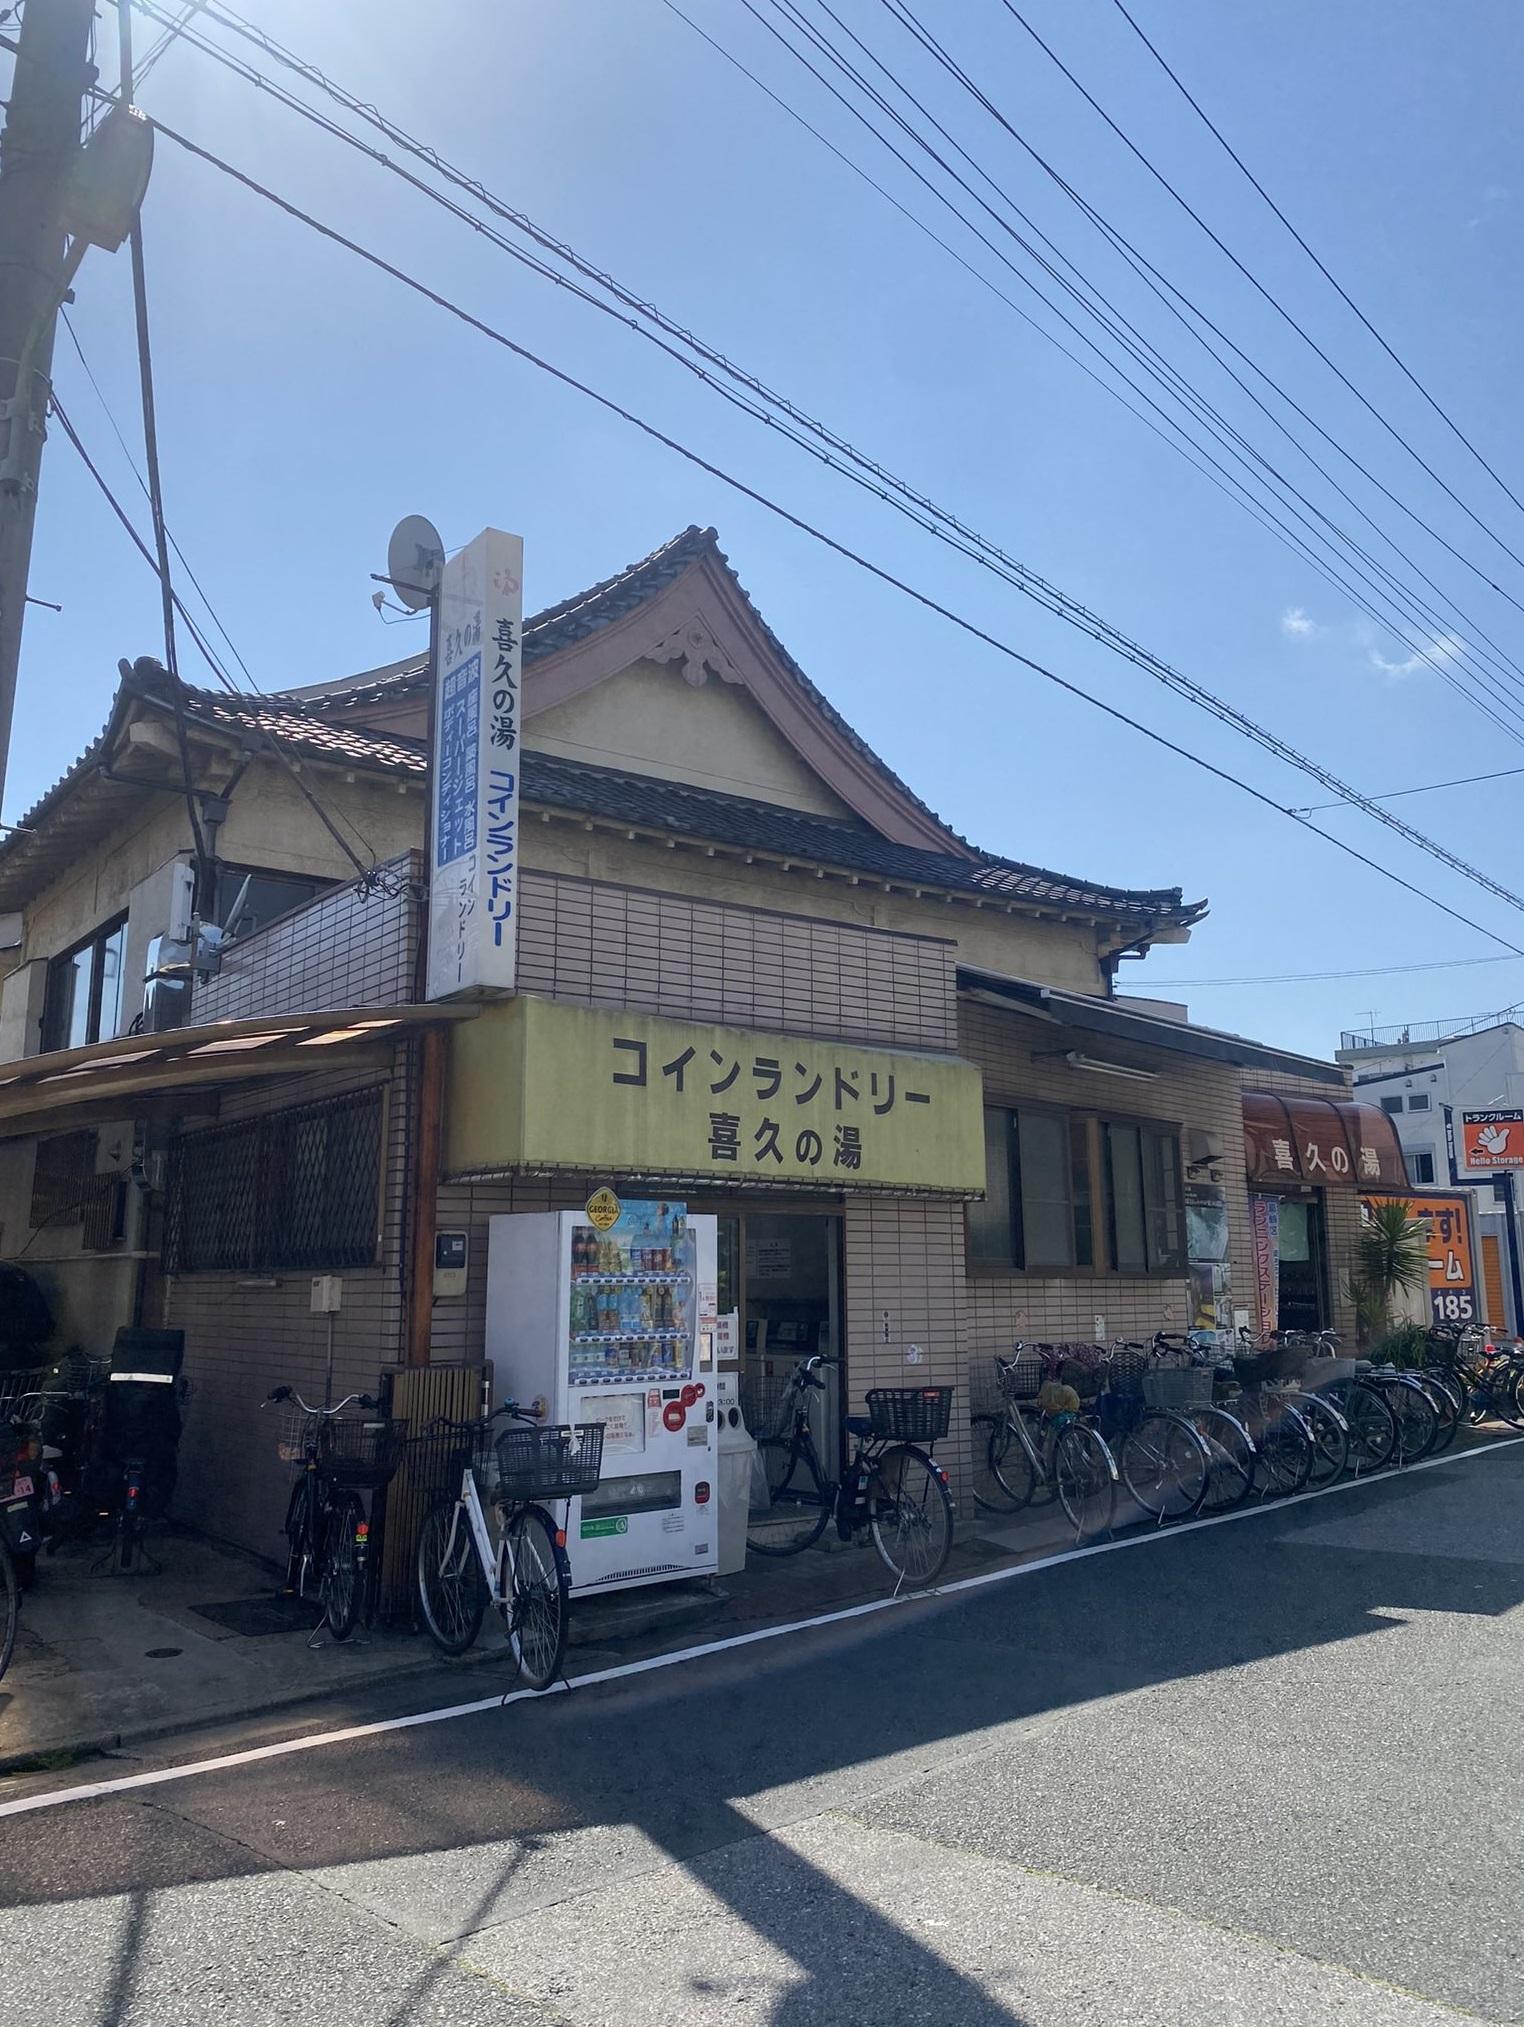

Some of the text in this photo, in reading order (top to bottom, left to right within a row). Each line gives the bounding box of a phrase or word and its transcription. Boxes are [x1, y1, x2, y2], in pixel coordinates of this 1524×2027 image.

[487, 618, 519, 947] 喜久の湯 コインランドリー
[467, 853, 476, 916] コイン
[458, 878, 467, 983] ランドリー
[612, 1037, 931, 1115] コインランドリー
[707, 1112, 863, 1171] 喜久の湯
[1465, 1112, 1522, 1122] トランクルーム
[1272, 1139, 1381, 1176] 喜久の湯
[1470, 1156, 1524, 1166] Hello Storage
[1433, 1294, 1473, 1321] 185
